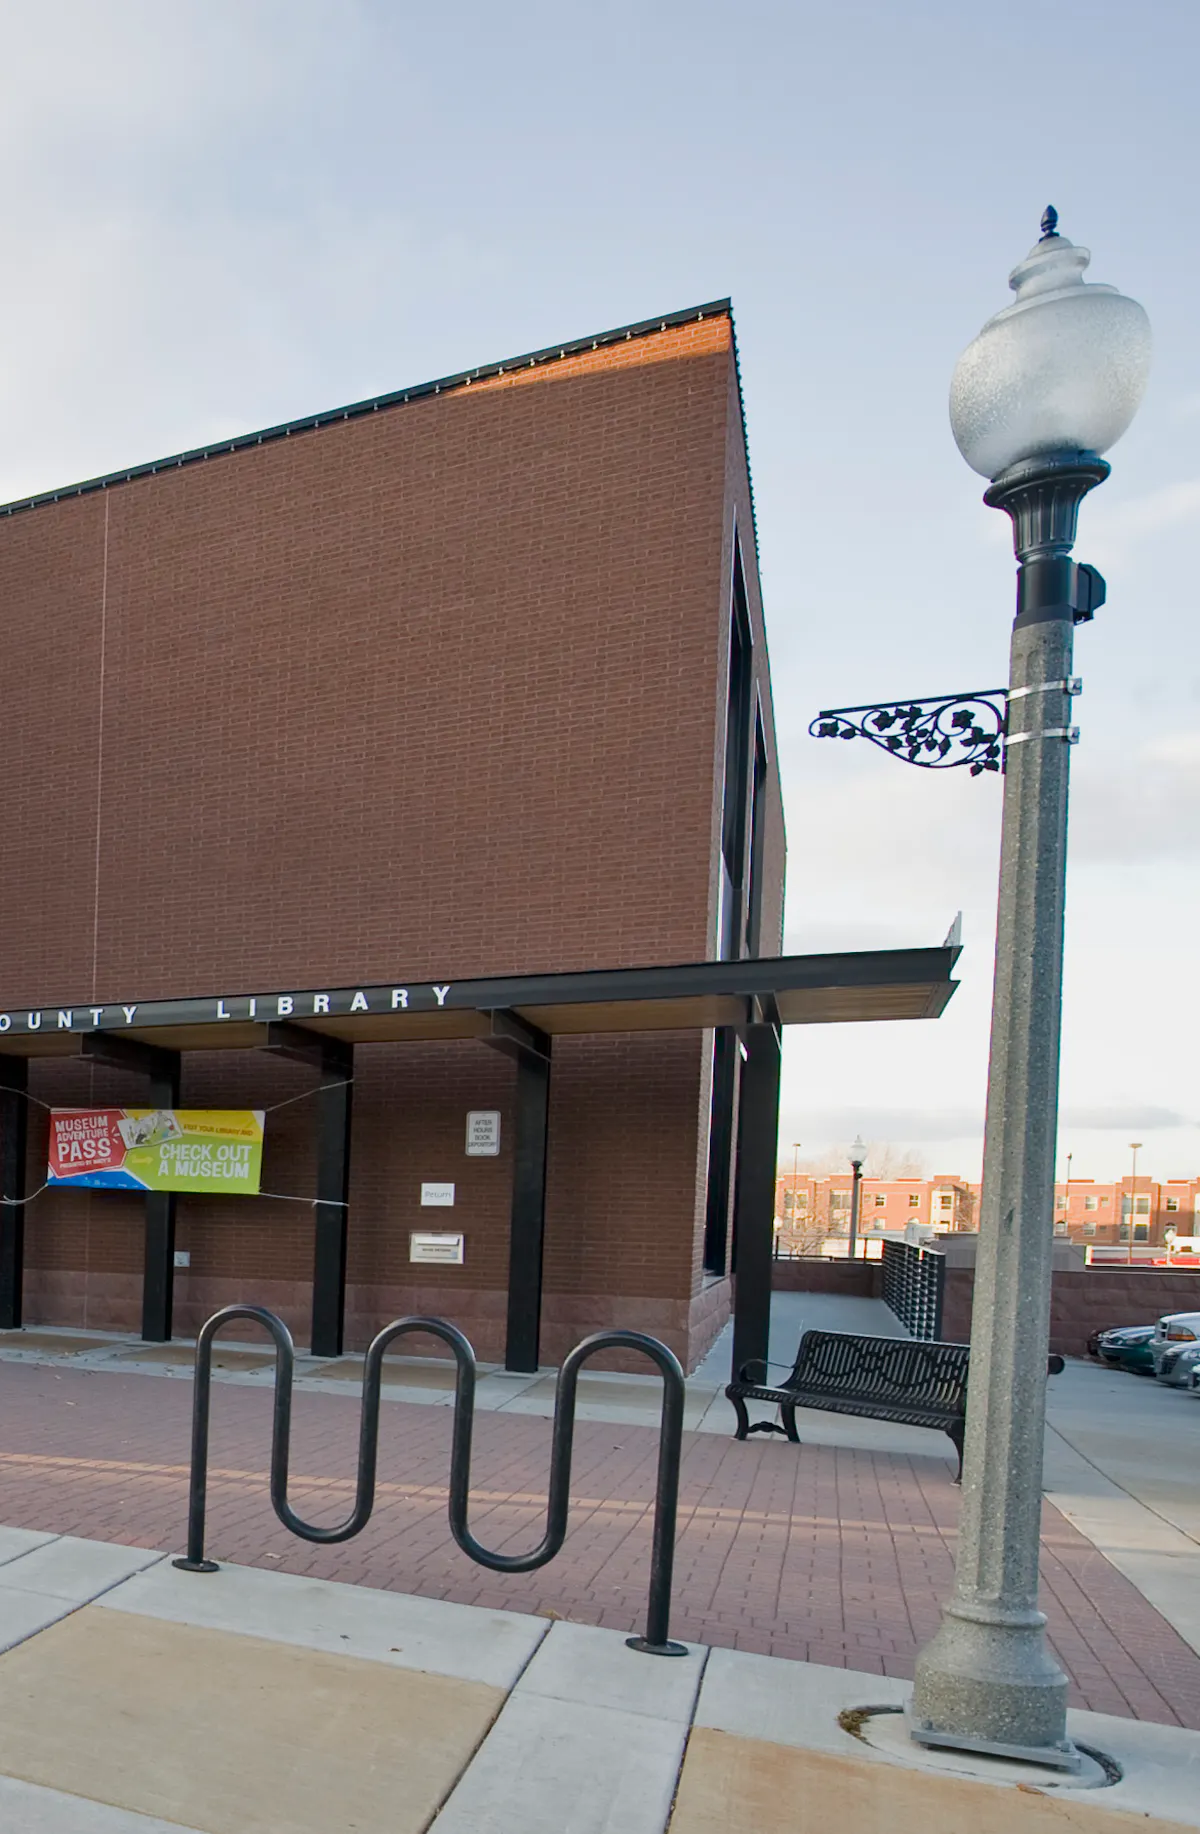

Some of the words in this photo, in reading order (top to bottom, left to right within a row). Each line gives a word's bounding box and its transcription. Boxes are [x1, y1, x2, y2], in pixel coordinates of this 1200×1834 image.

[216, 985, 450, 1019] LIBRARY
[55, 1115, 108, 1133] MUSEUM
[56, 1127, 109, 1143] ADVENTURE
[57, 1138, 112, 1162] PASS
[160, 1143, 212, 1161] CHECK
[217, 1144, 252, 1161] OUT
[157, 1159, 169, 1176] A
[174, 1160, 249, 1178] MUSEUM
